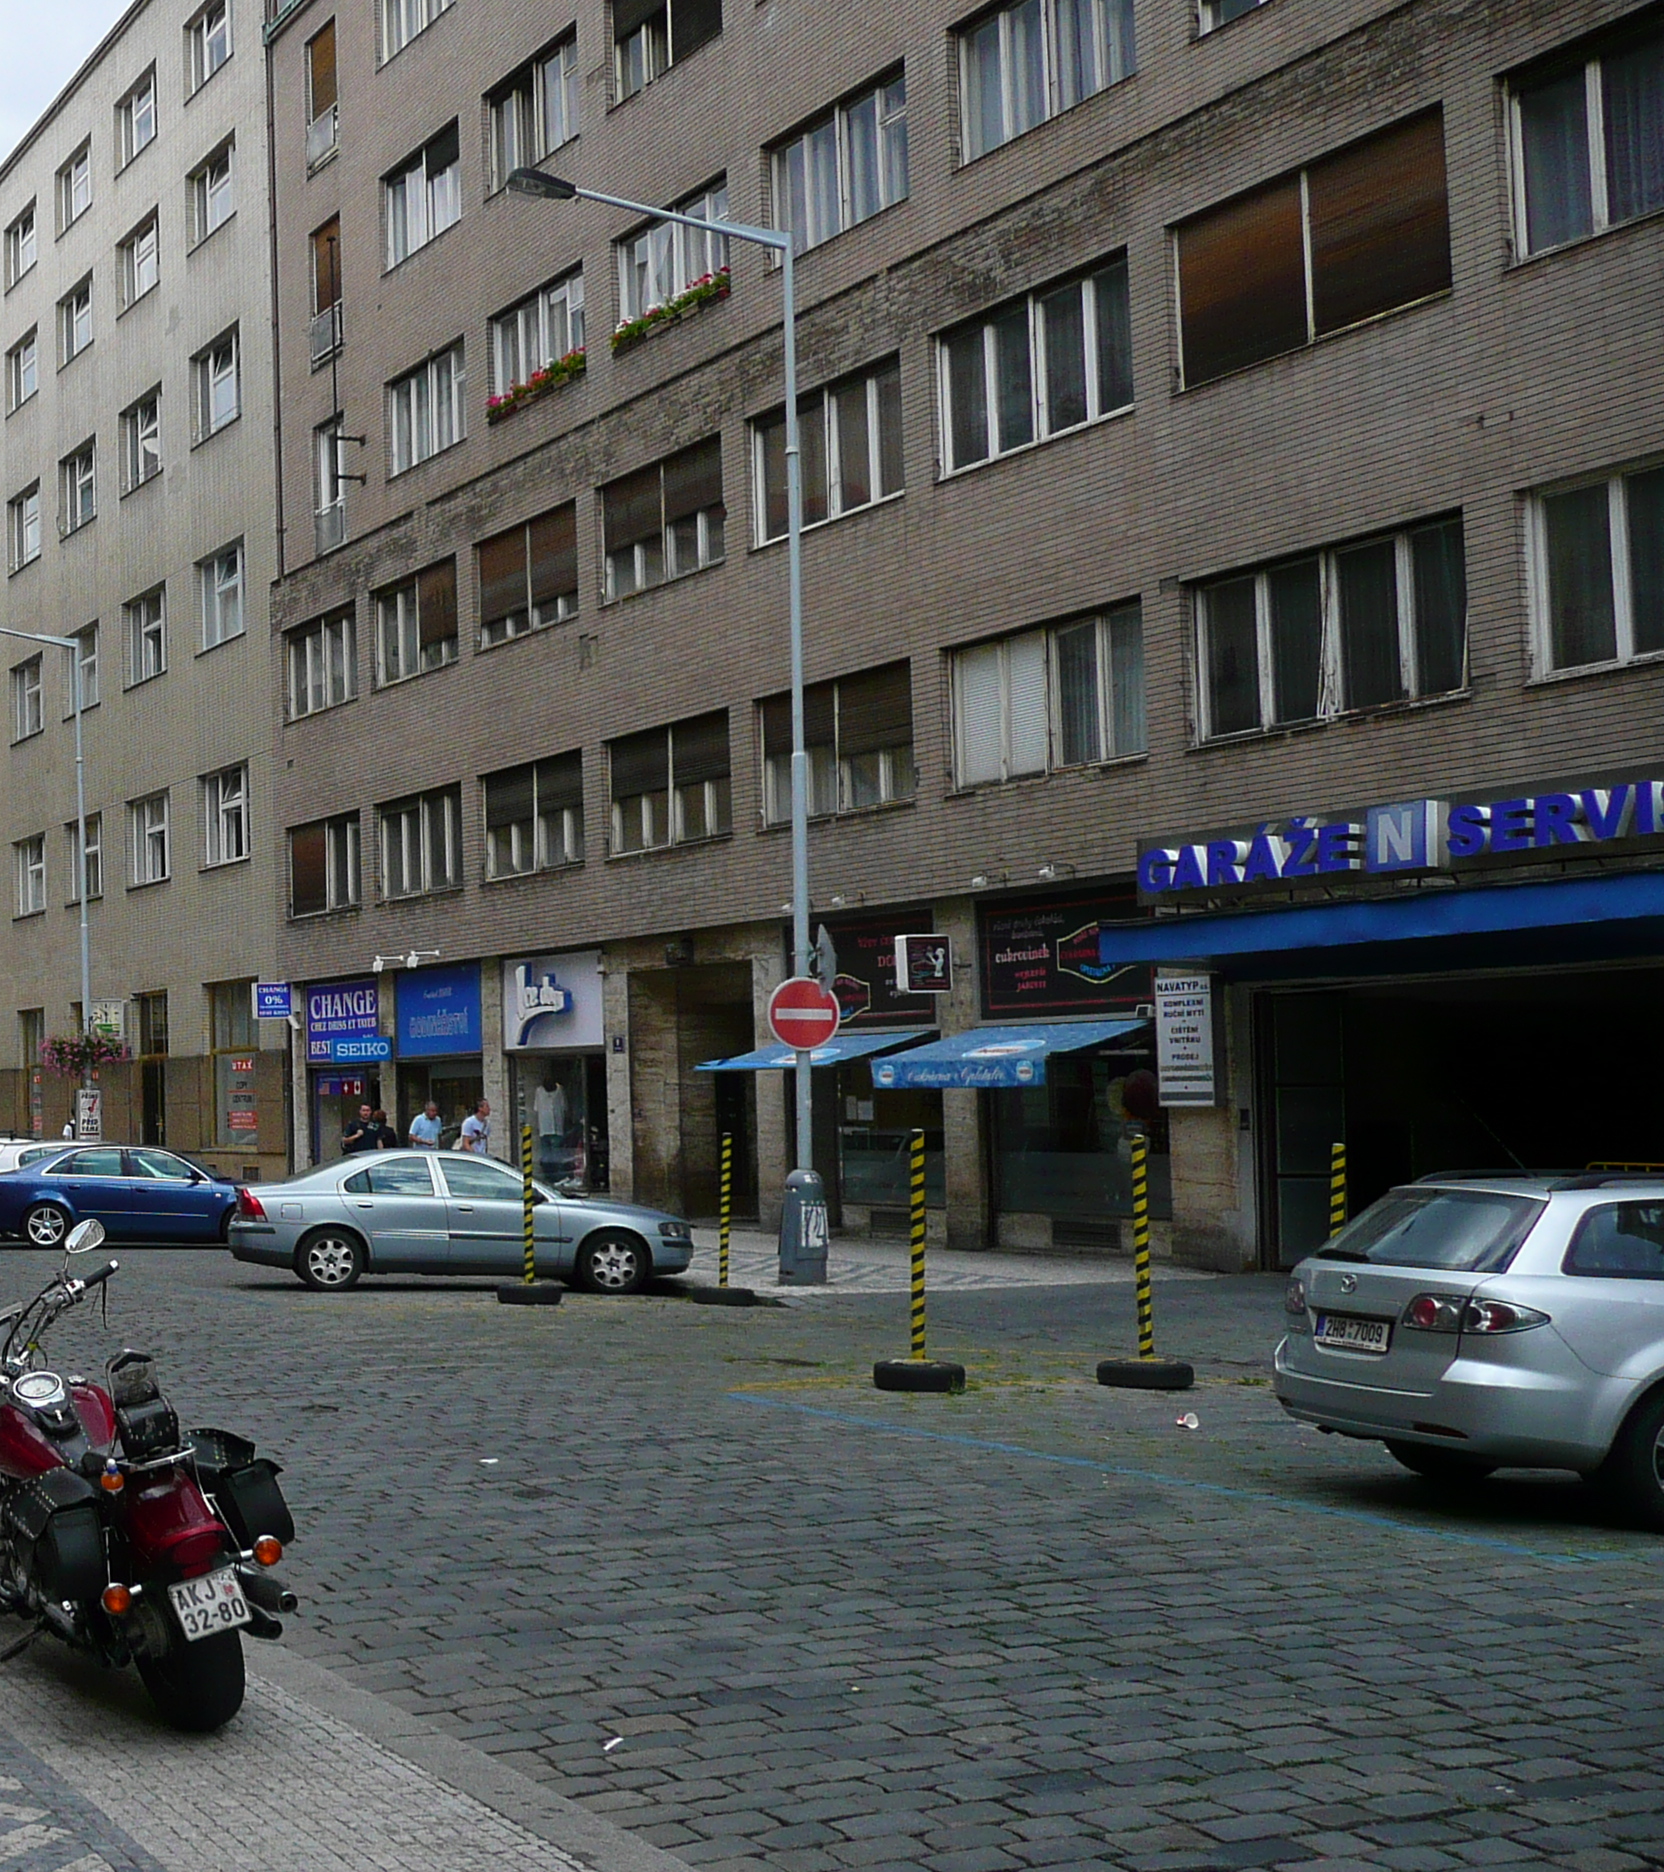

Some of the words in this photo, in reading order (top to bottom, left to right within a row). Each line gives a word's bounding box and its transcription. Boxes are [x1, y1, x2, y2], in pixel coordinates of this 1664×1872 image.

[1137, 816, 1352, 893] GARÁŽE
[1446, 781, 1664, 857] SERVI
[265, 995, 284, 1004] 0%
[1157, 981, 1199, 992] NAVATYP
[310, 989, 377, 1020] CHANGE
[310, 1040, 331, 1055] BEST
[336, 1041, 389, 1057] SEIKO
[1325, 1318, 1347, 1339] 2H8
[1353, 1321, 1383, 1344] 7009
[176, 1579, 216, 1611] AKJ
[184, 1597, 245, 1634] 32-80
